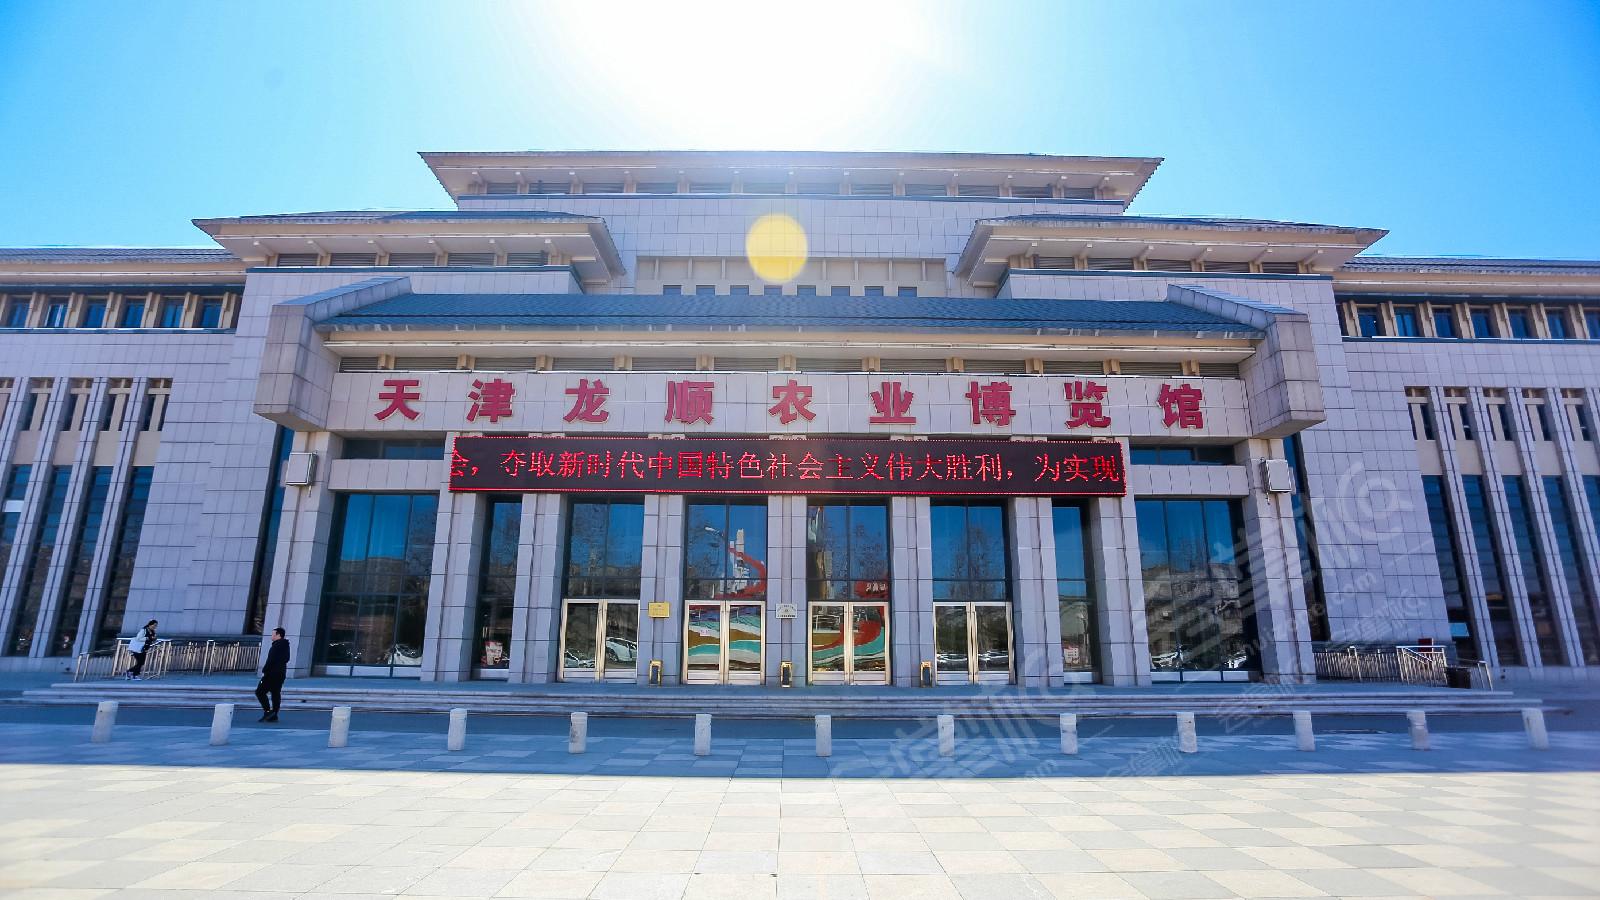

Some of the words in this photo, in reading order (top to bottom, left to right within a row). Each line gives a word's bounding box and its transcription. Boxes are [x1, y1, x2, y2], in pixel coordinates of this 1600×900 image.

[375, 377, 1205, 430] 天津龙顺农业博览馆
